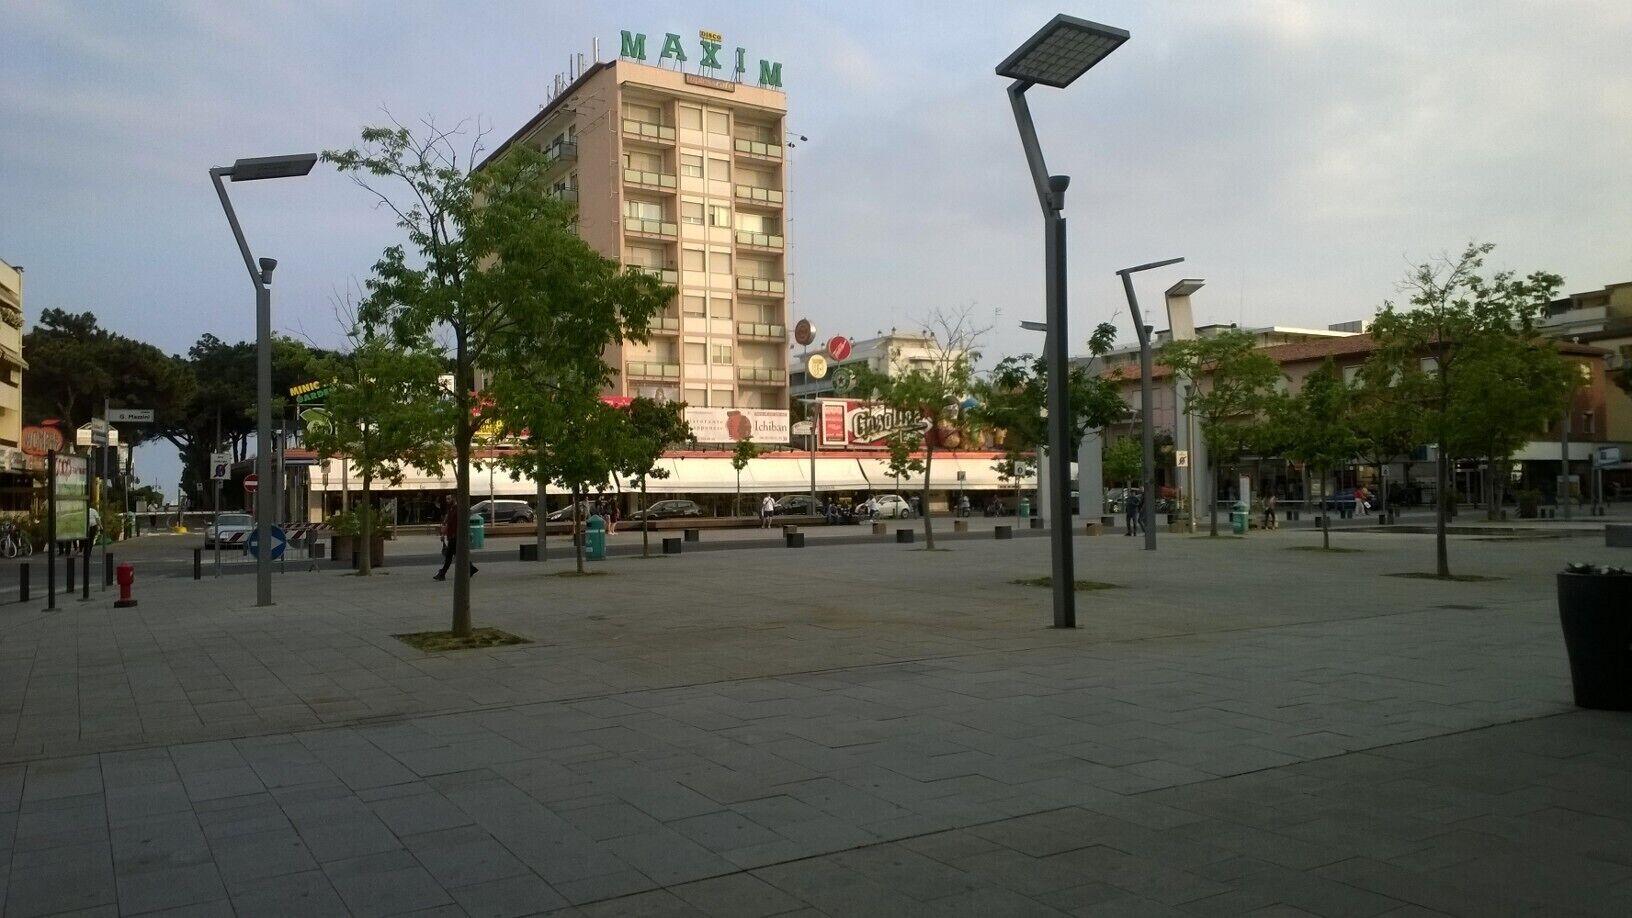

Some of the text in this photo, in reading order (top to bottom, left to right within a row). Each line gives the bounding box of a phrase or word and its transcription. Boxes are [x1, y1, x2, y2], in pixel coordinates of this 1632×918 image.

[701, 31, 722, 40] DISCO
[620, 29, 783, 87] MAXIM
[755, 420, 788, 432] Ichiban
